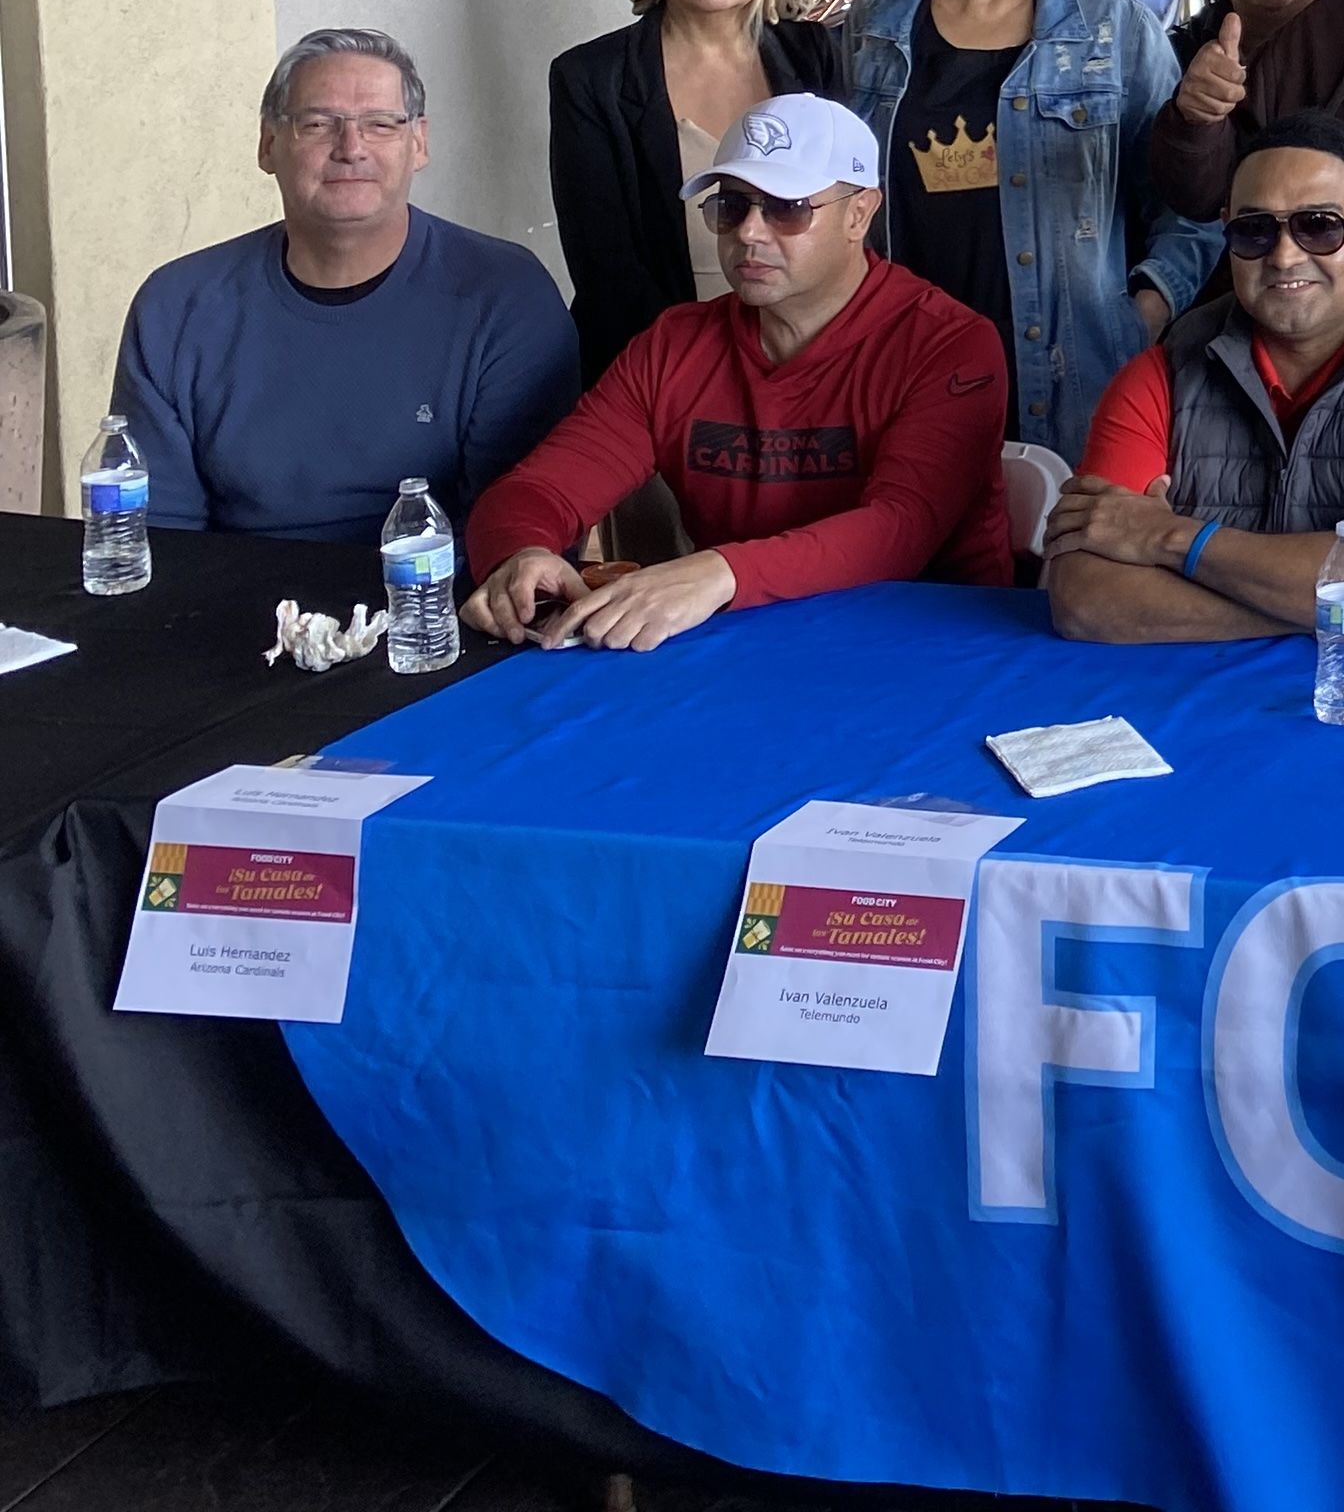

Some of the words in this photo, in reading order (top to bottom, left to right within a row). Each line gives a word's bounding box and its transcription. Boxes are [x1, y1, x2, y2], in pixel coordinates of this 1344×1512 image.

[732, 433, 819, 452] AZONA
[260, 868, 301, 882] Casa
[231, 883, 323, 901] Tamales!
[852, 896, 875, 906] FOOD
[876, 897, 897, 907] CITY
[859, 912, 905, 926] Casa
[827, 928, 927, 946] Tamales!
[190, 944, 216, 957] Luis
[220, 946, 291, 962] Hernandez
[191, 962, 231, 974] Arizona
[235, 964, 285, 978] Cardinals
[780, 989, 809, 1003] Ivan
[815, 992, 888, 1010] Valenzuela
[799, 1008, 860, 1024] Telemundo
